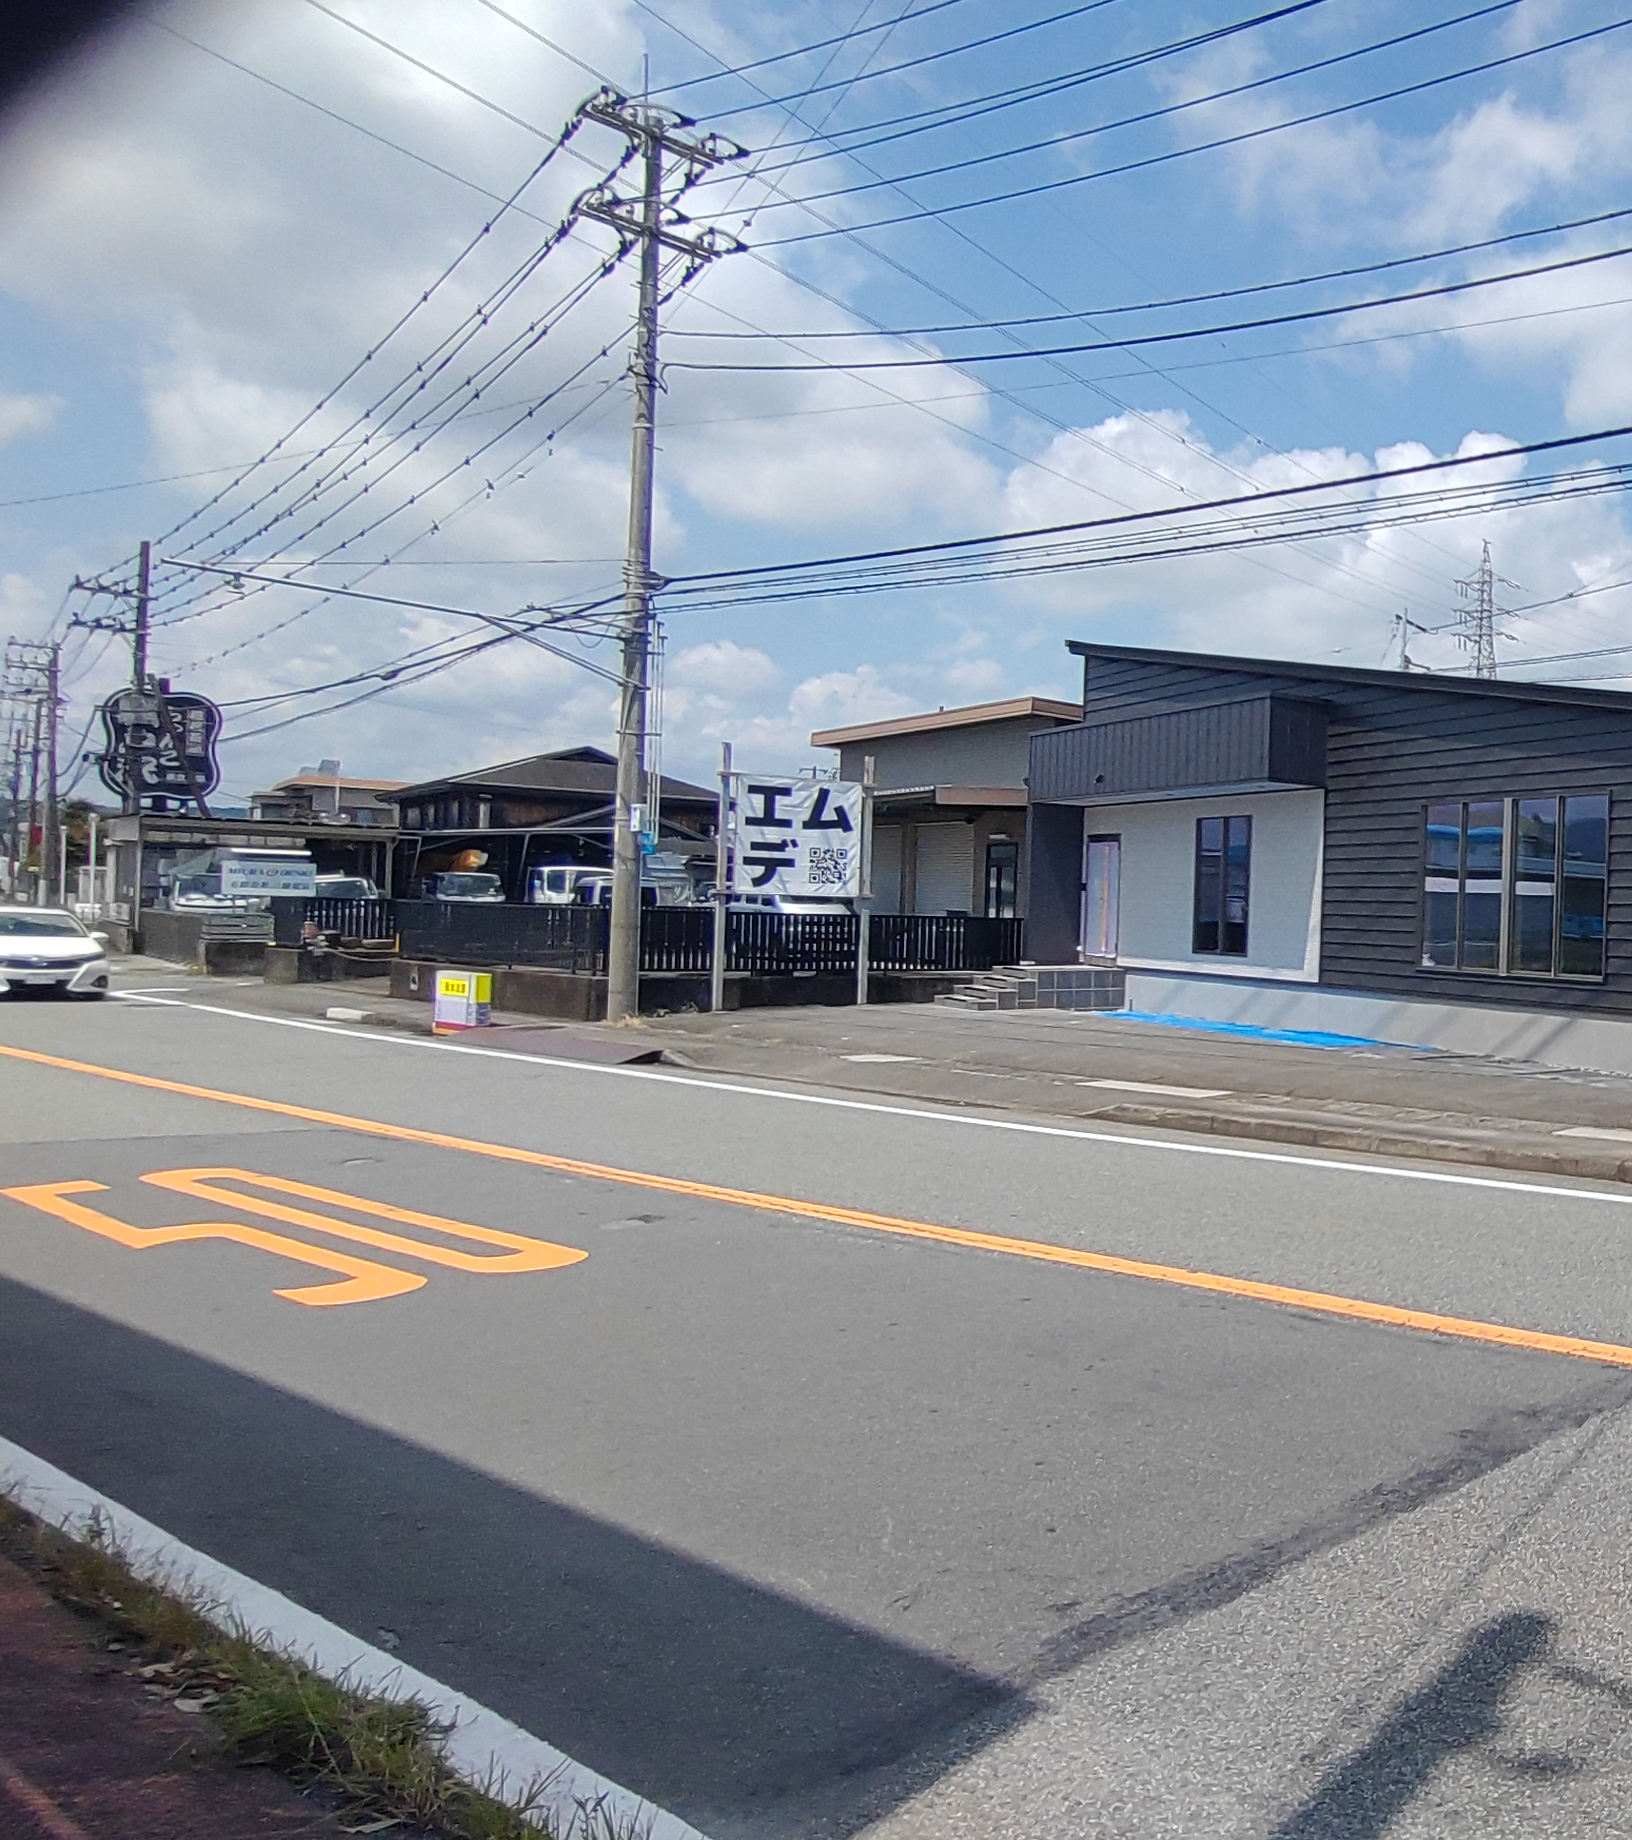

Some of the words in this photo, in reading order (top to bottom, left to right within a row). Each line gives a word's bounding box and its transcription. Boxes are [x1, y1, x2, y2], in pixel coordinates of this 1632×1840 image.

[745, 784, 854, 833] エム
[743, 838, 799, 888] デ
[0, 1167, 589, 1306] 50
